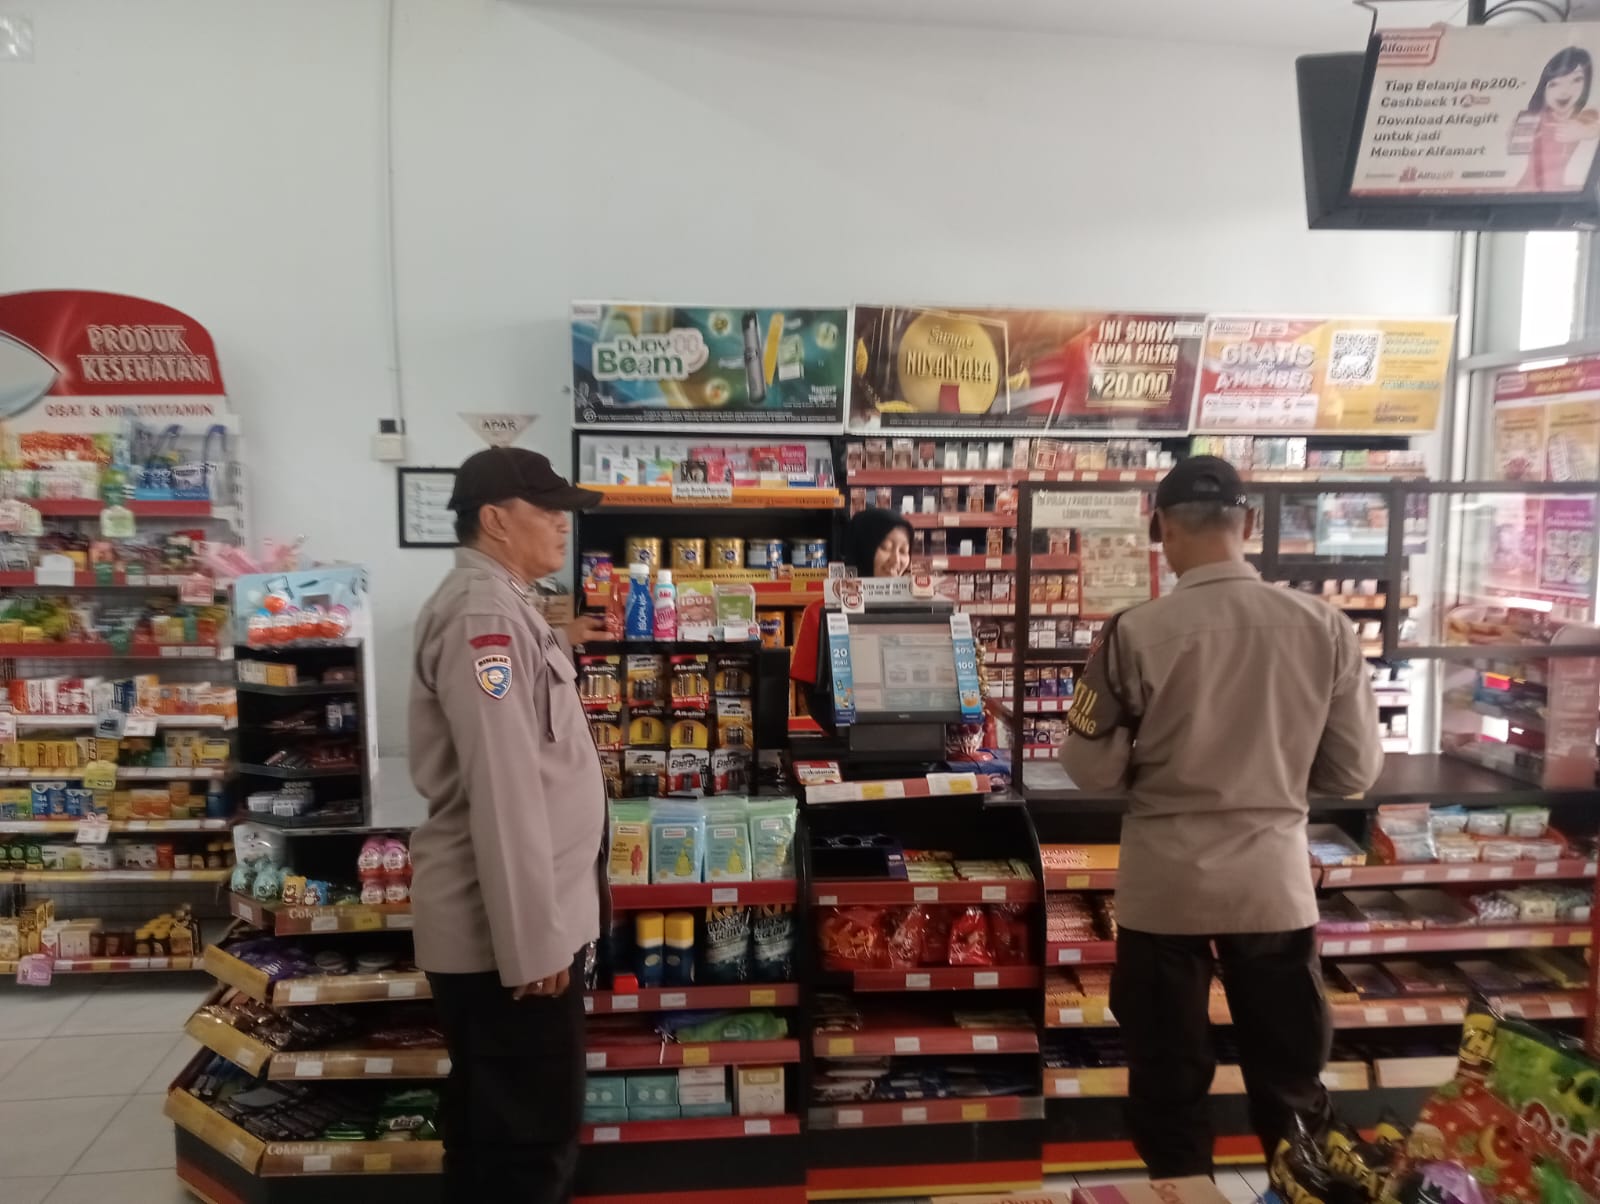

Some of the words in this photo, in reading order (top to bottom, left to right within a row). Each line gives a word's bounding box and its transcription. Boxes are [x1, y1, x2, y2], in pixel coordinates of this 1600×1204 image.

[1385, 80, 1413, 93] Tiap
[1416, 79, 1467, 92] Belanja
[1381, 96, 1447, 108] Cashback
[1377, 114, 1443, 126] Download
[1446, 113, 1499, 127] Alfagift
[1374, 130, 1412, 142] untuk
[1415, 130, 1441, 142] jadi
[1370, 146, 1423, 158] Member
[1426, 145, 1486, 157] Alfamart
[1098, 320, 1122, 343] INI
[1125, 320, 1177, 343] SURYA
[87, 325, 188, 353] PRODUK
[1135, 343, 1179, 364] FILTER
[1221, 342, 1314, 368] GRATIS
[78, 355, 213, 383] KESEHATAN
[598, 350, 684, 374] Beam
[906, 351, 993, 384] NUSANTARA
[833, 648, 848, 658] 20
[584, 664, 617, 673] Alkaline
[674, 663, 706, 671] Alkaline
[958, 661, 974, 669] 100
